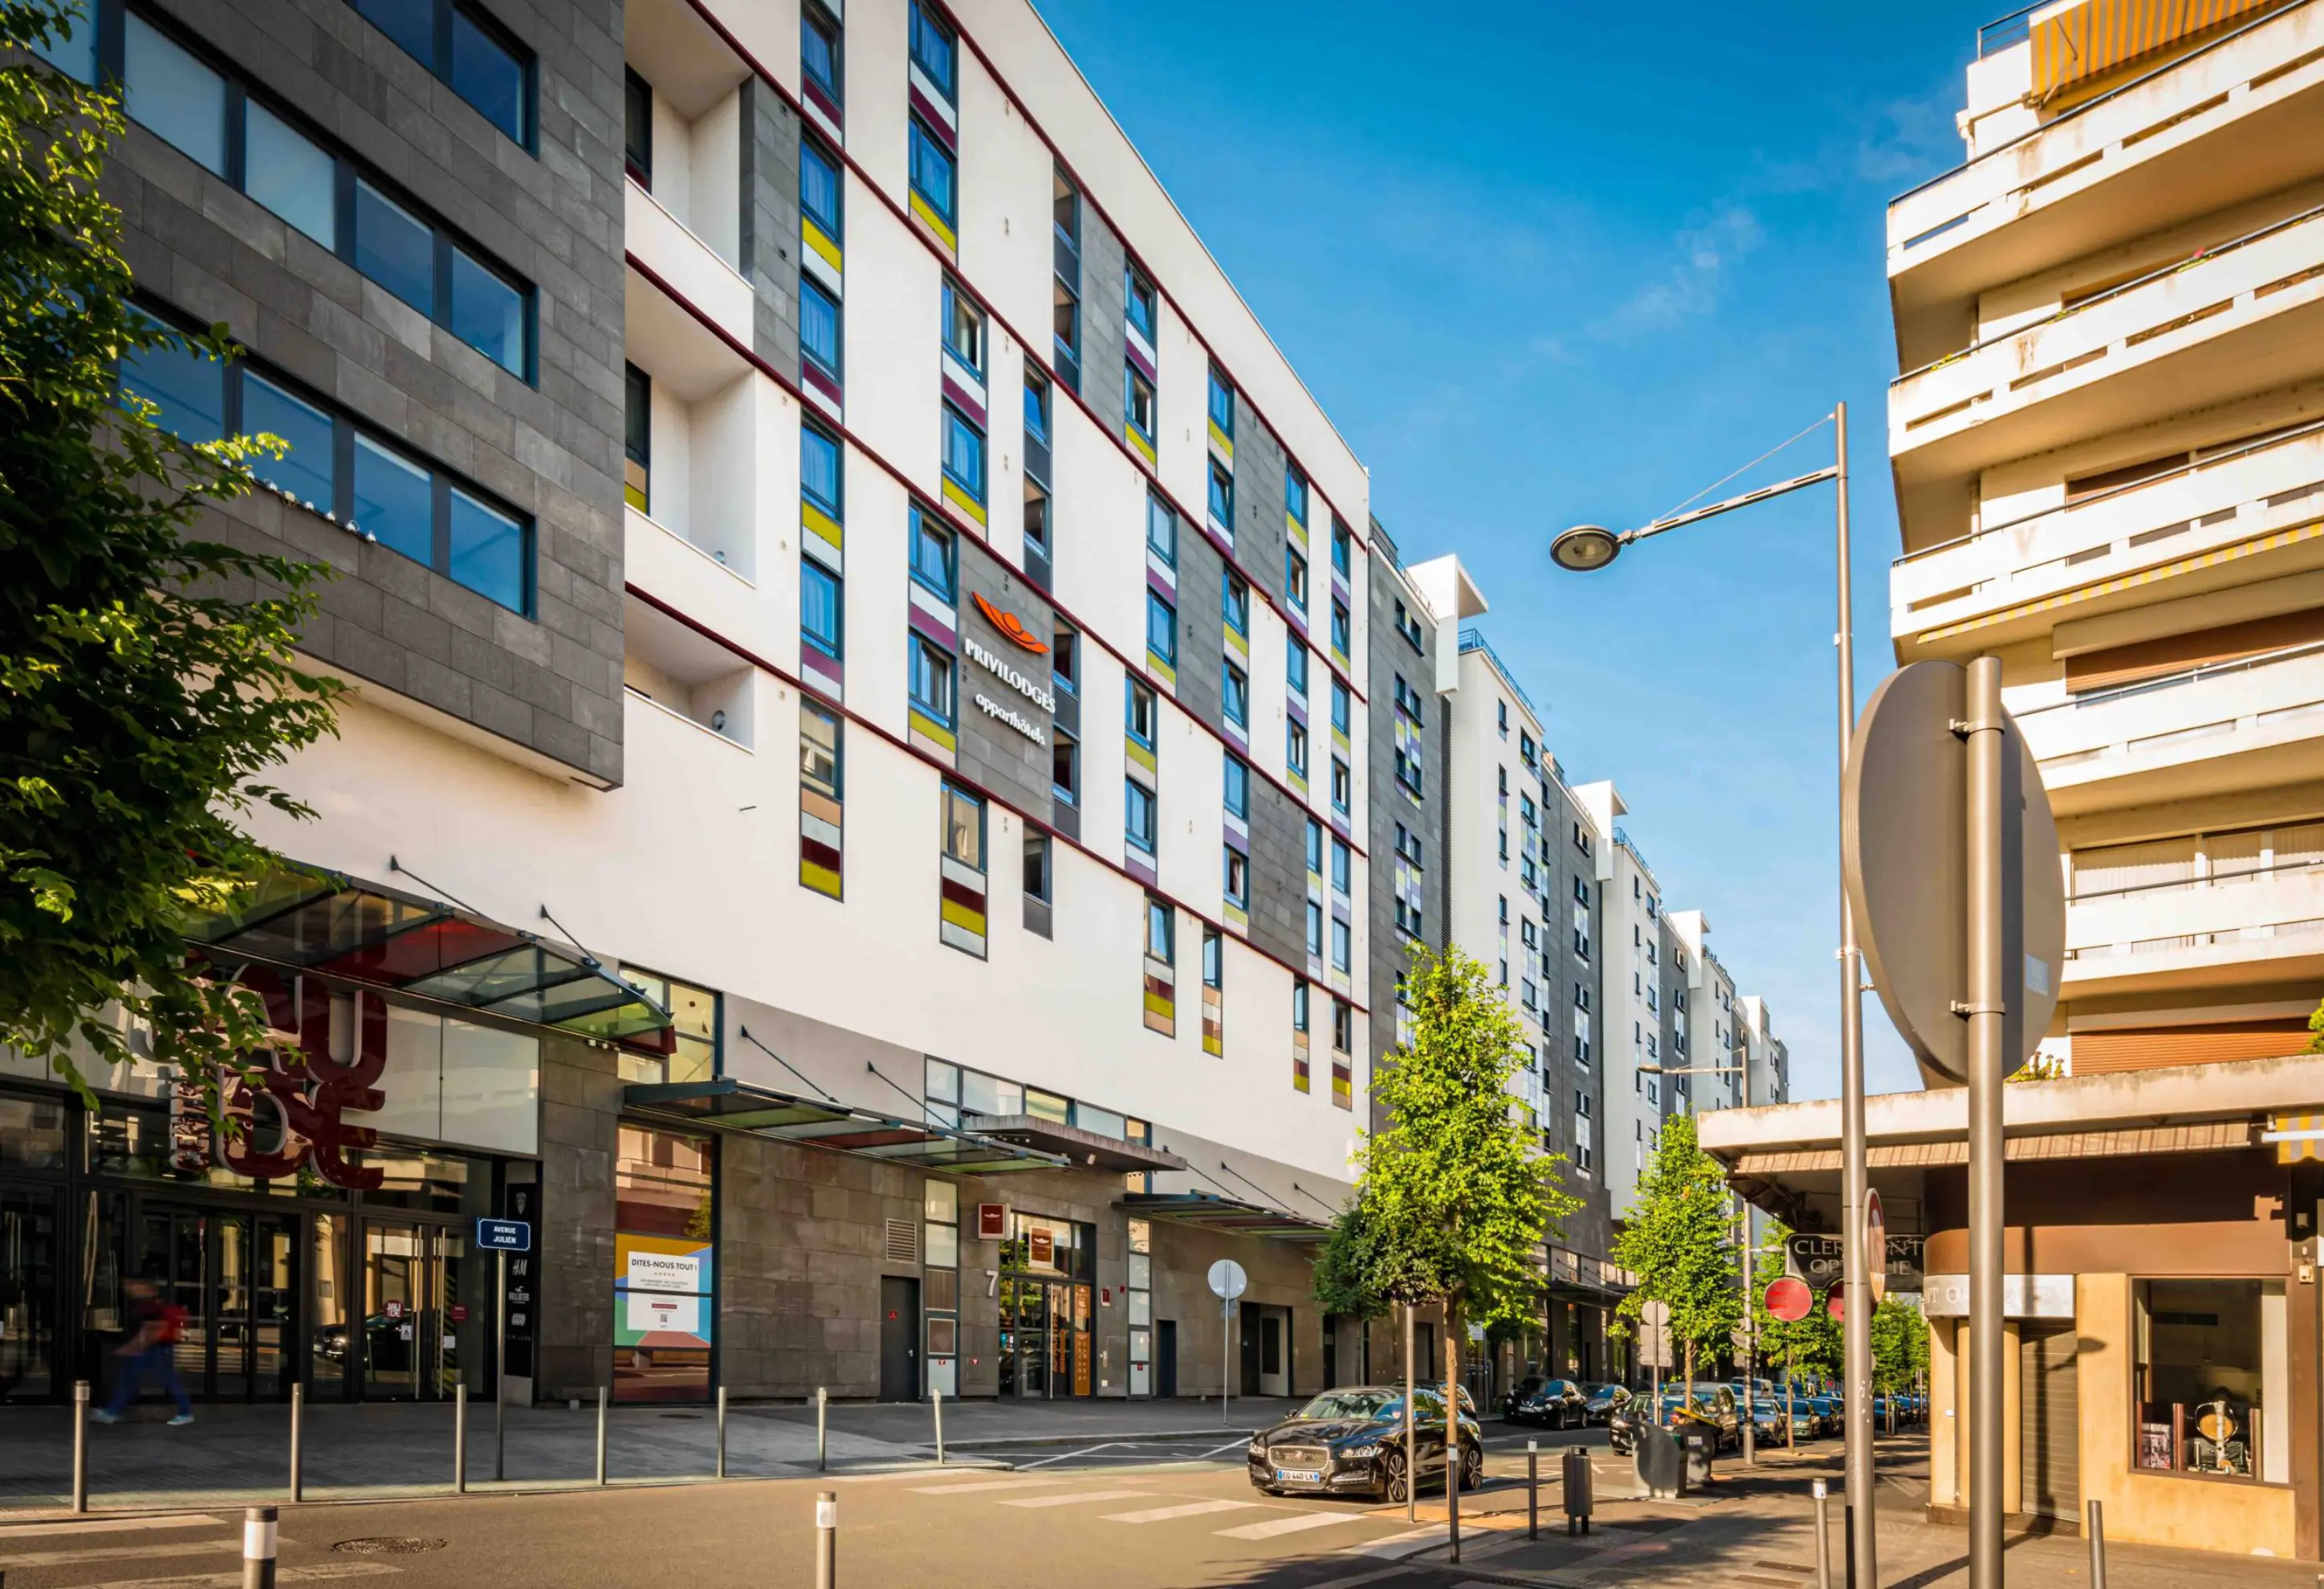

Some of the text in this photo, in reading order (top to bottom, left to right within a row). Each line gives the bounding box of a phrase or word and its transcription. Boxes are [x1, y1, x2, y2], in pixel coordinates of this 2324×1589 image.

[964, 637, 1056, 714] PRIVILODGES
[975, 693, 1046, 746] apparthôtels
[493, 1225, 516, 1234] AVENUE
[493, 1235, 516, 1244] JULIEN
[631, 1258, 674, 1270] DITES-NOUS
[676, 1262, 694, 1271] TOUT
[986, 1270, 999, 1297] 7
